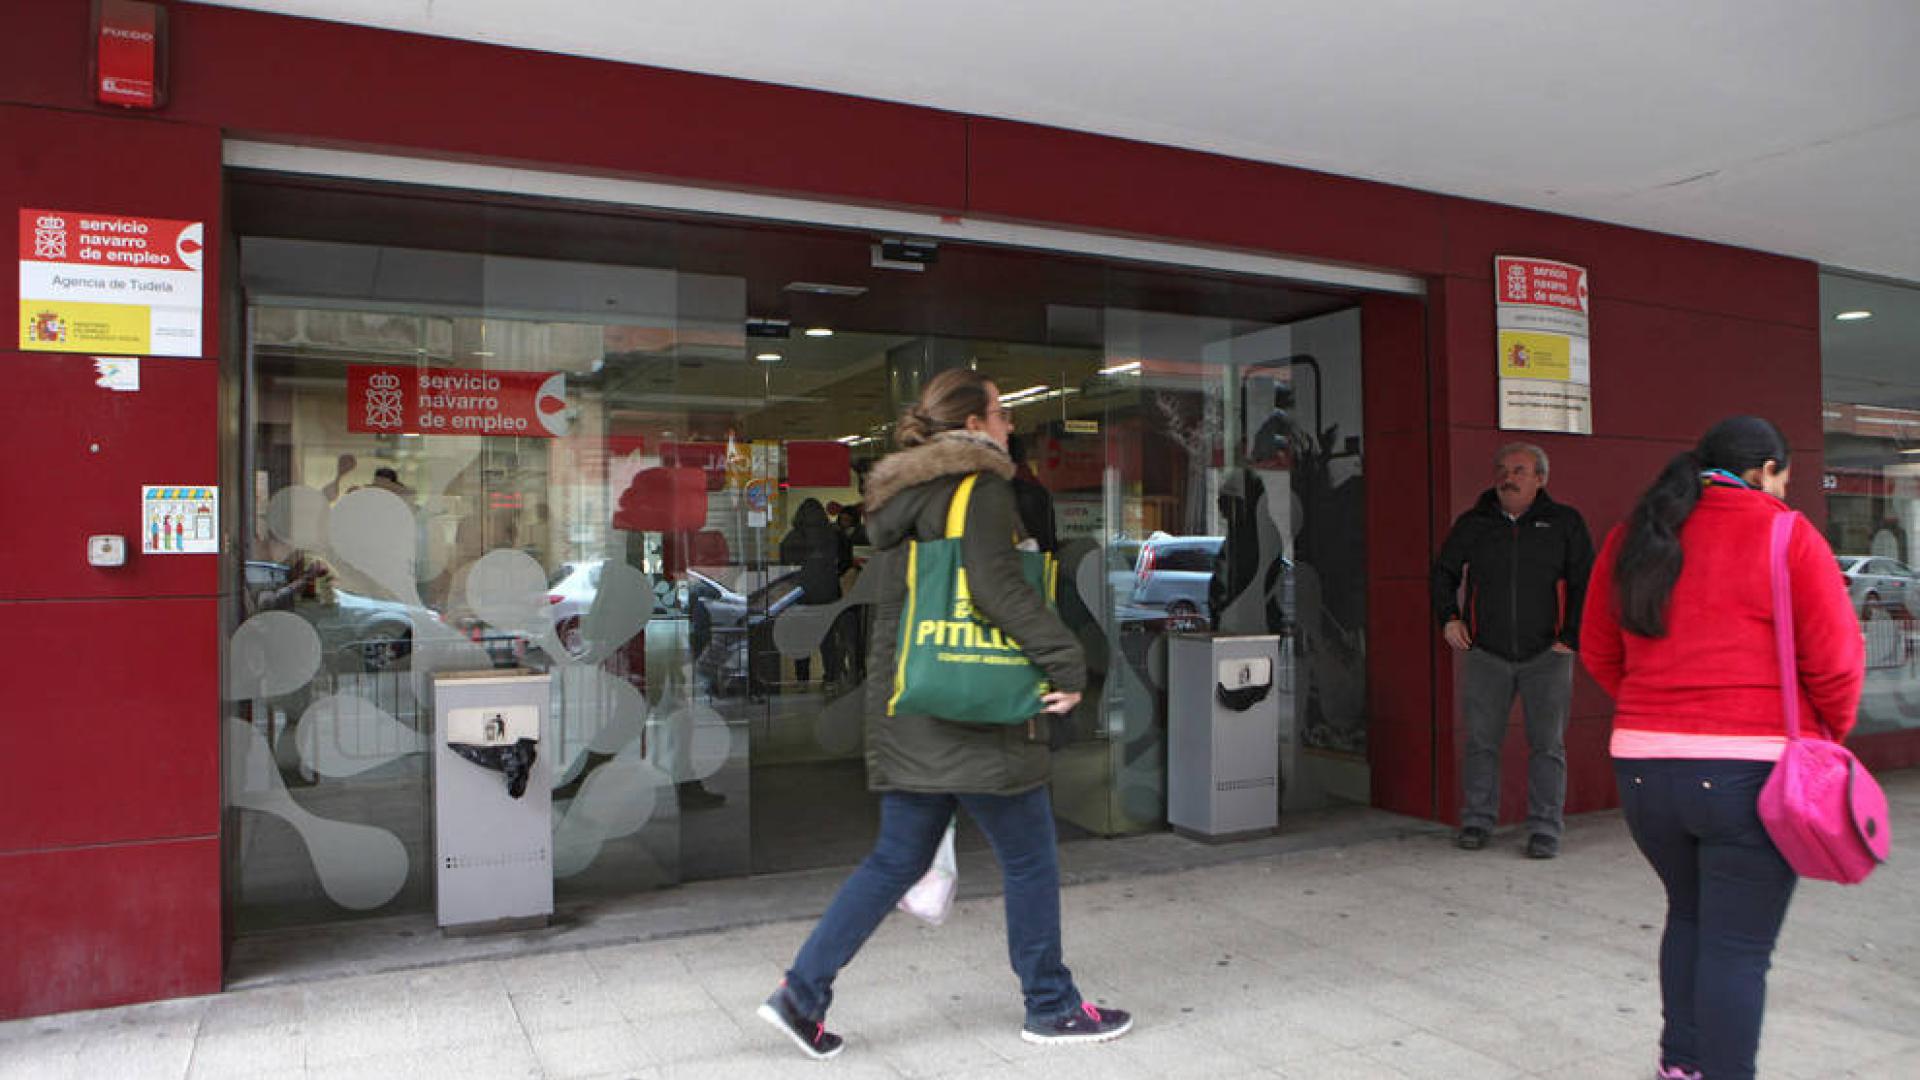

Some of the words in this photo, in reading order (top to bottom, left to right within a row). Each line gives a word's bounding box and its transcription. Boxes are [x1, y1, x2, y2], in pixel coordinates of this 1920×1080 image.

[80, 219, 148, 234] servicio
[80, 234, 146, 249] navarro
[80, 247, 102, 261] de
[106, 250, 170, 265] empleo
[52, 275, 105, 292] Agencia
[109, 277, 126, 289] de
[130, 279, 173, 293] Tudela
[419, 373, 500, 391] servicio
[419, 394, 499, 410] navarro
[419, 412, 446, 428] de
[451, 414, 529, 433] empleo
